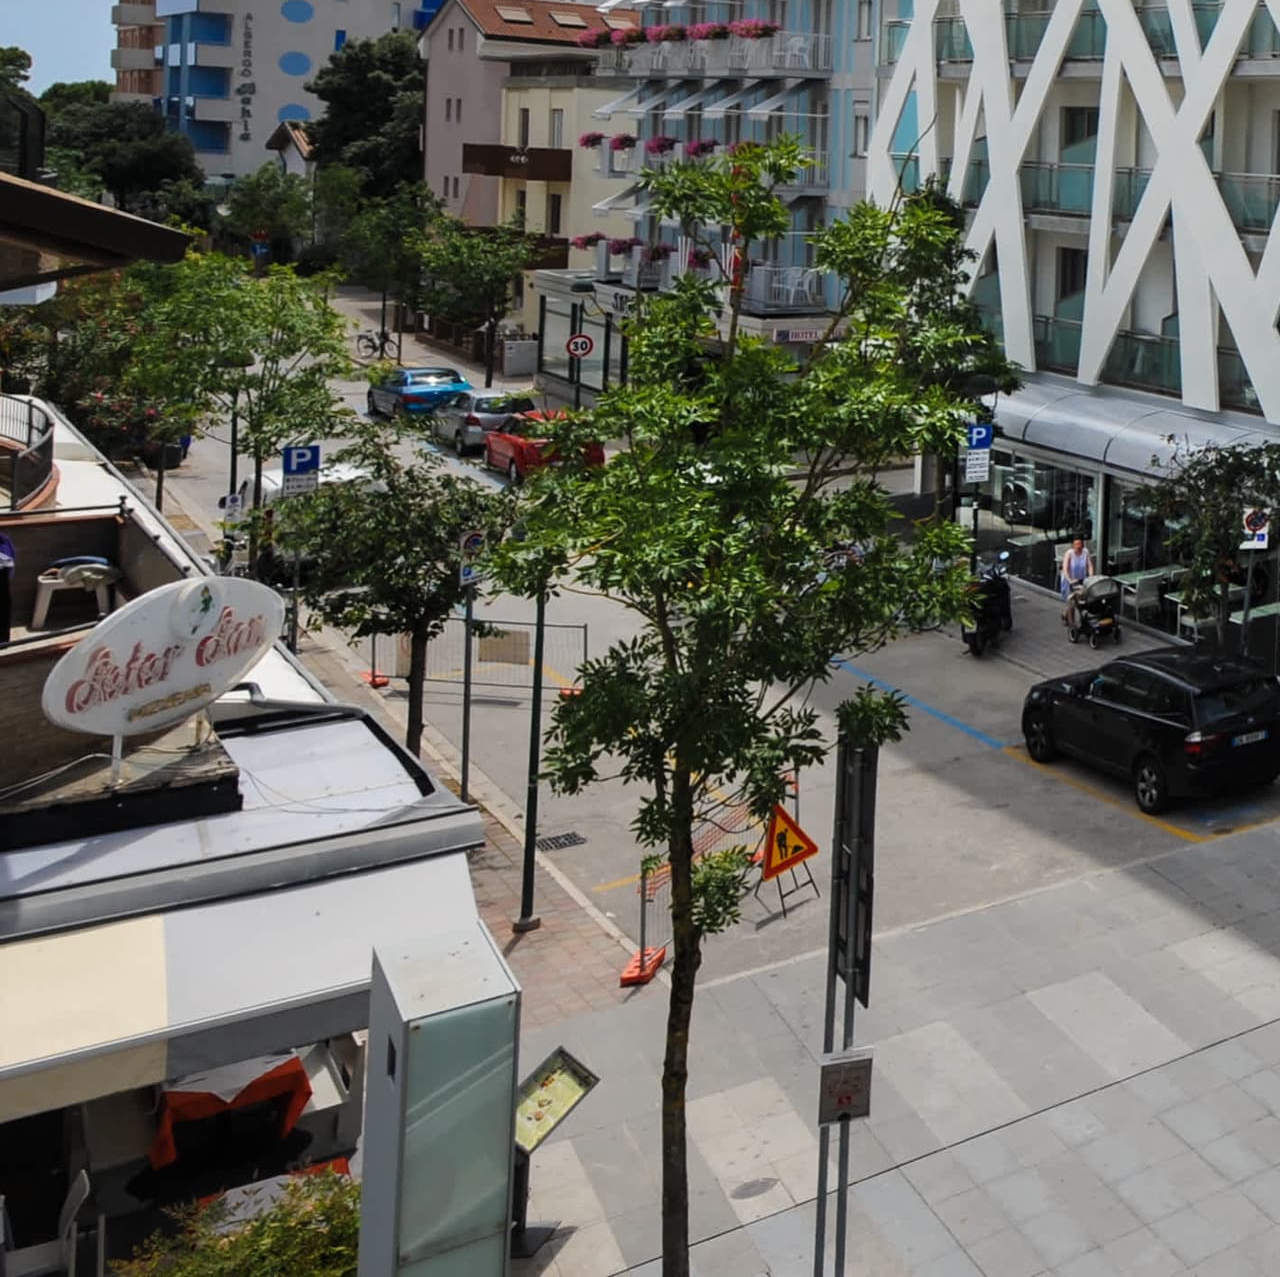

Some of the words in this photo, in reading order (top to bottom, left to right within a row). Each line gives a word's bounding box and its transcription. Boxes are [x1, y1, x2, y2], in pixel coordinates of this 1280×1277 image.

[241, 12, 253, 78] ALBERGO
[572, 340, 588, 352] 30
[971, 427, 987, 446] P
[290, 448, 312, 471] P
